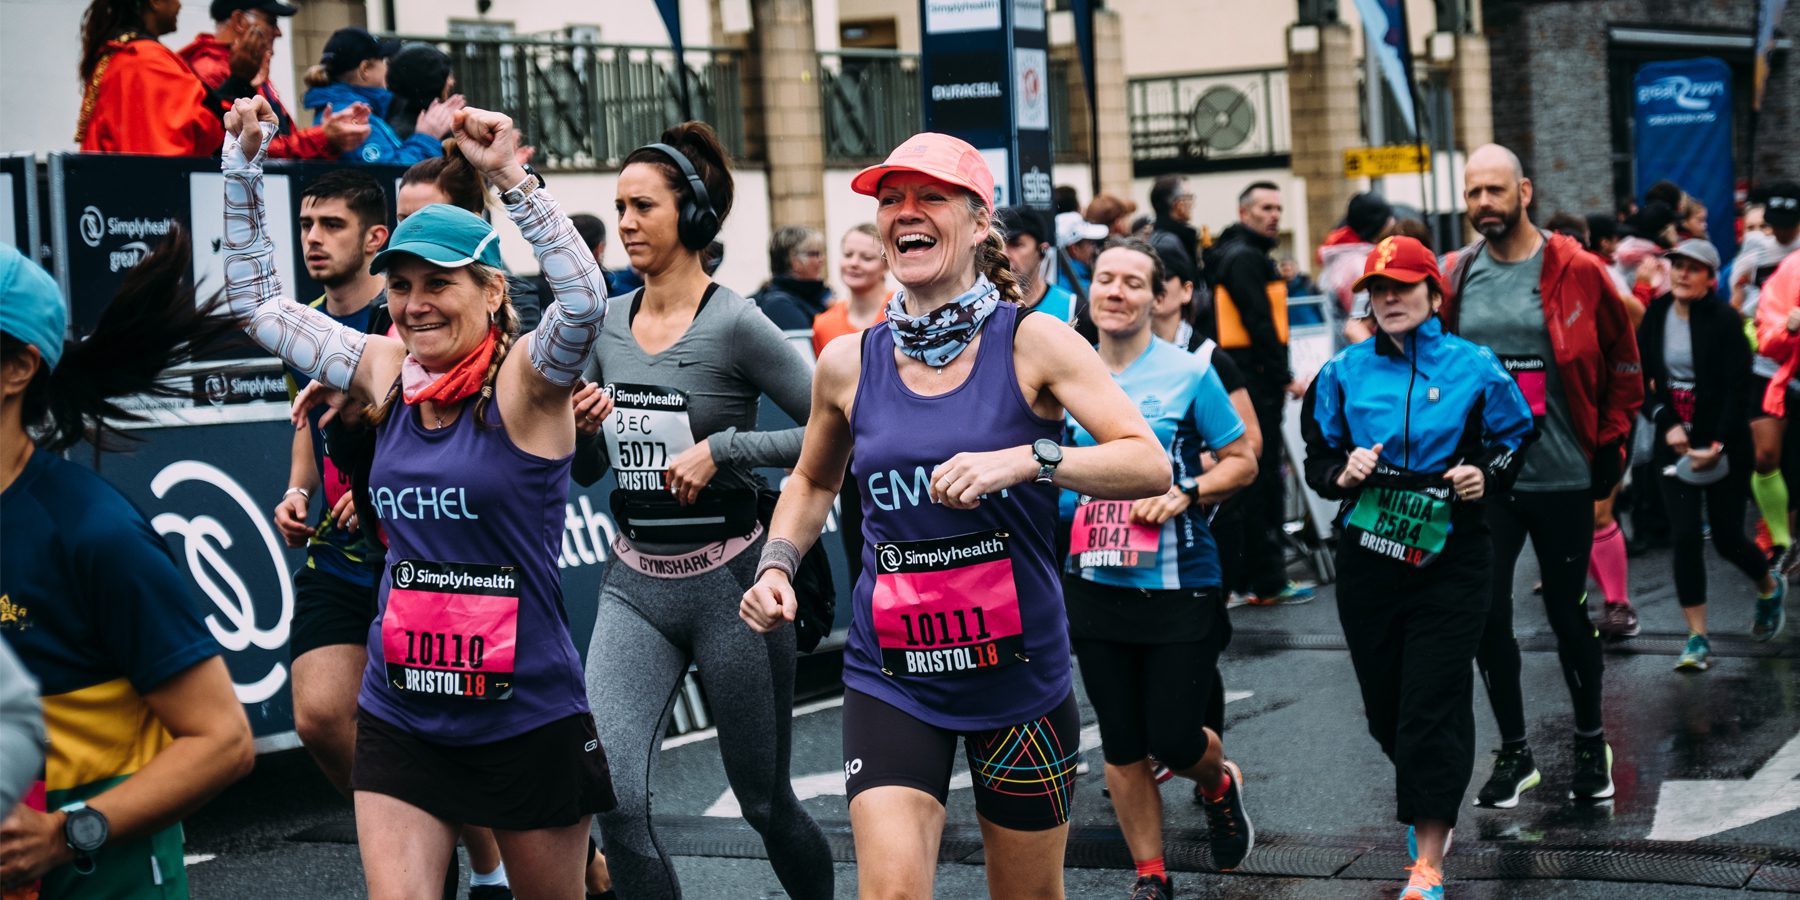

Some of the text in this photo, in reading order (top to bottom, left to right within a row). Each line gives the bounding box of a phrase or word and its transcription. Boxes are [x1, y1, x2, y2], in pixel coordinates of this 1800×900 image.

[932, 82, 1001, 100] DURACELL
[616, 390, 684, 407] Simplyhealth
[616, 410, 652, 435] BEC
[618, 441, 667, 468] 5077
[618, 471, 670, 491] BRISTOL
[1377, 487, 1434, 523] MINDA
[1087, 526, 1131, 548] 8041
[1373, 510, 1424, 545] 6584
[638, 551, 714, 575] GYMSHARK
[905, 538, 1004, 567] Simplyhealth
[416, 569, 515, 589] Simplyhealth
[901, 606, 991, 646] 10111
[404, 630, 485, 669] 10110
